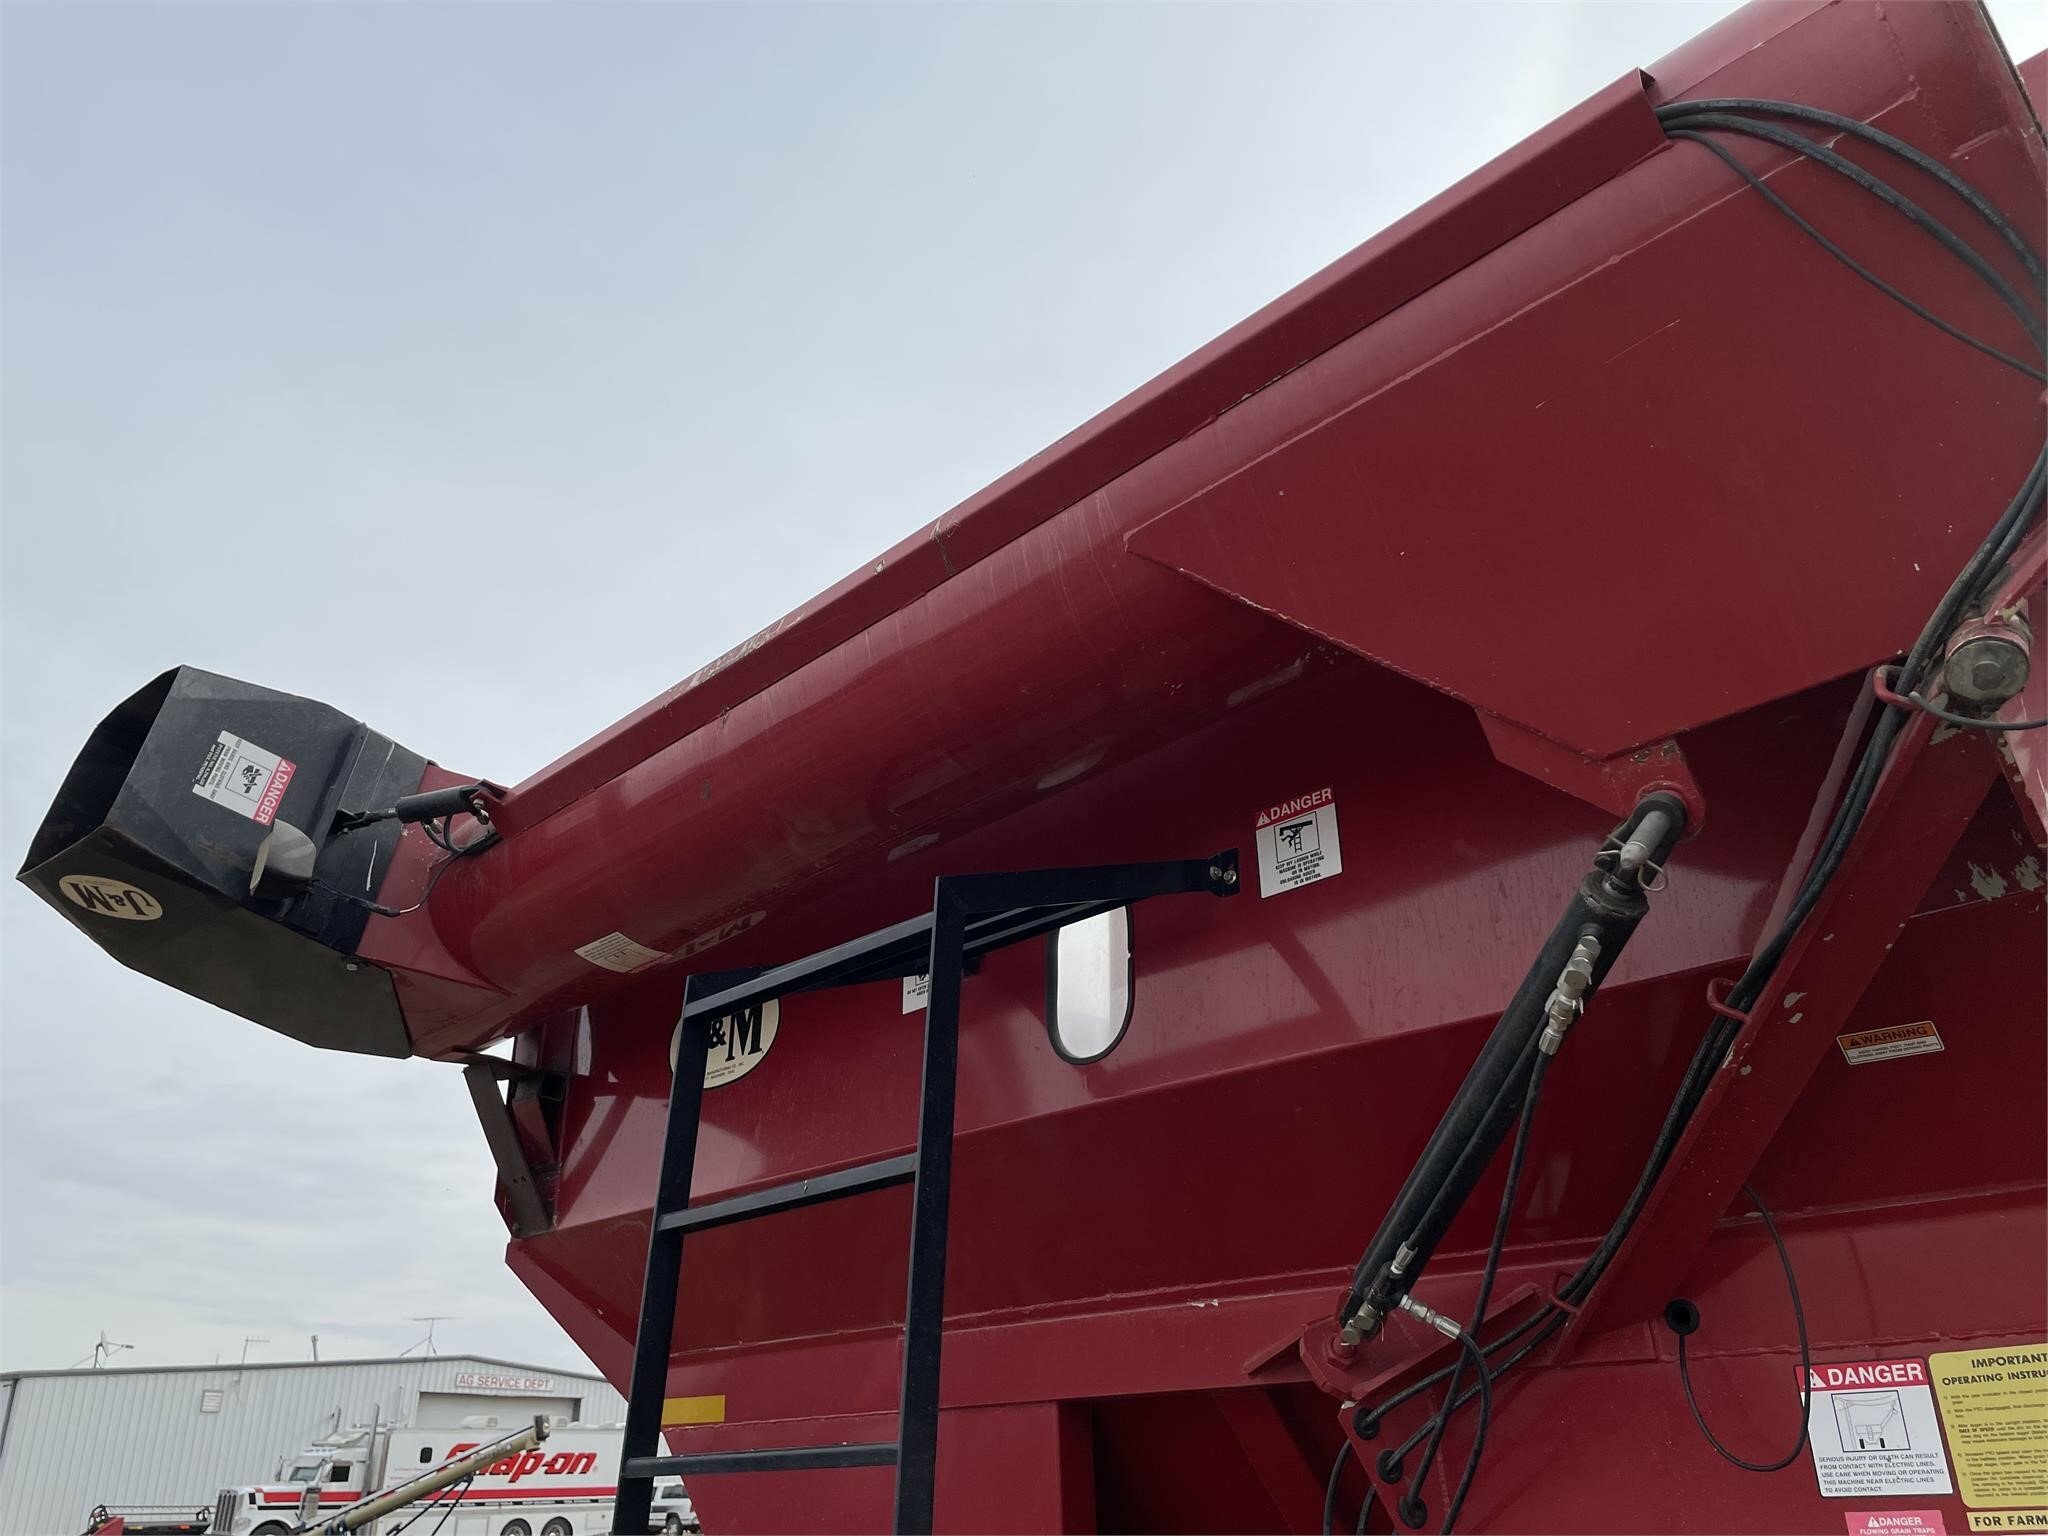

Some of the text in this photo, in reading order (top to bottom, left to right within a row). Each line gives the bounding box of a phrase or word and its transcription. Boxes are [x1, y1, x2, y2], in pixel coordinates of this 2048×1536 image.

[257, 773, 287, 824] DANGER
[1270, 787, 1332, 820] DANGER
[68, 882, 154, 916] J&M
[702, 1003, 763, 1062] &M
[1862, 1026, 1927, 1044] WARNING
[1972, 1353, 2048, 1368] IMPORTANT
[458, 1375, 550, 1388] AG SERVICE DEPT
[1827, 1363, 1924, 1386] DANGER
[1942, 1370, 2048, 1385] OPERATING INSTRU
[445, 1443, 597, 1483] Sap-on
[1878, 1517, 1922, 1526] DANGER
[1974, 1517, 2001, 1526] FOR
